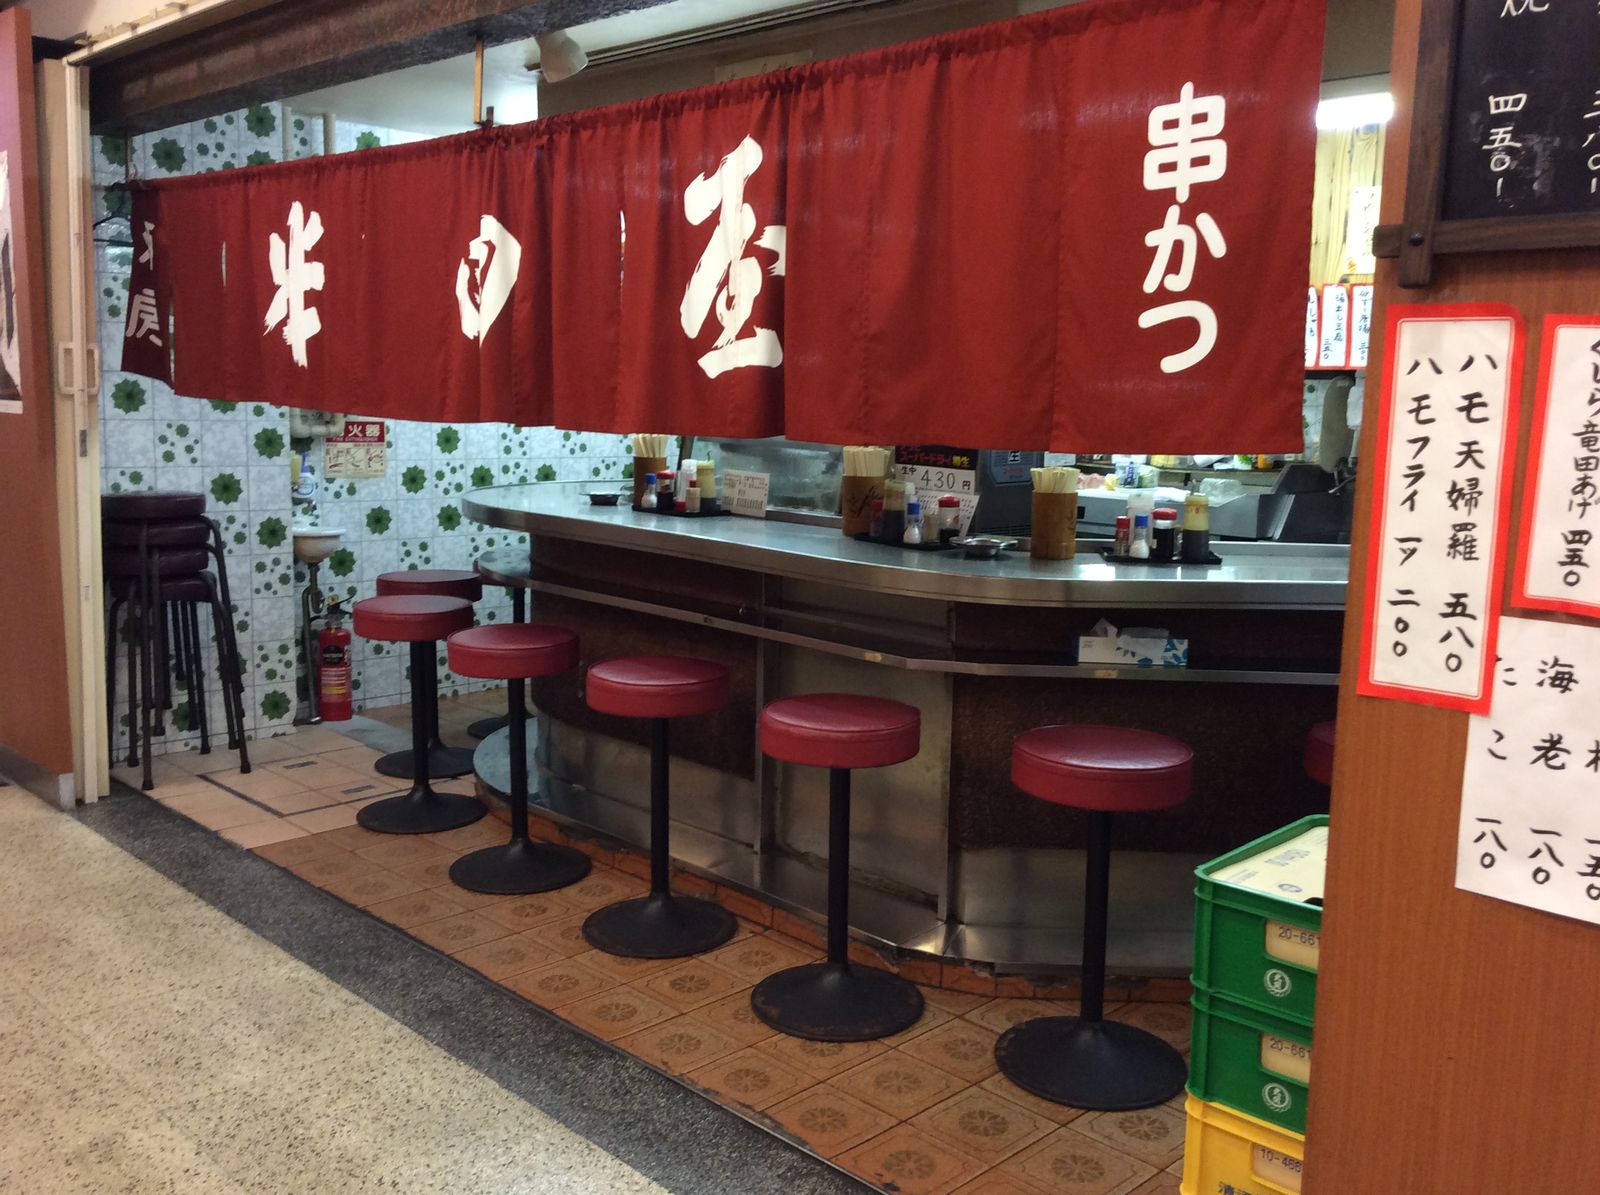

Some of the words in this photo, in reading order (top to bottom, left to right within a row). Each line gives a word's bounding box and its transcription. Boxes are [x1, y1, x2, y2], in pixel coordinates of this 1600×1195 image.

[1138, 81, 1228, 374] 串かつ
[339, 424, 381, 437] 火器
[1400, 357, 1443, 512] ハモフライ
[1446, 354, 1499, 562] ハモ天婦羅
[920, 469, 956, 490] 430
[962, 480, 971, 491] 円
[1557, 529, 1593, 587] 四五〇
[1386, 589, 1421, 657] 二〇〇
[1439, 592, 1477, 673] 五八〇
[1529, 656, 1579, 771] 海老
[1472, 816, 1508, 869] 一八〇
[1527, 827, 1565, 885] 一八〇
